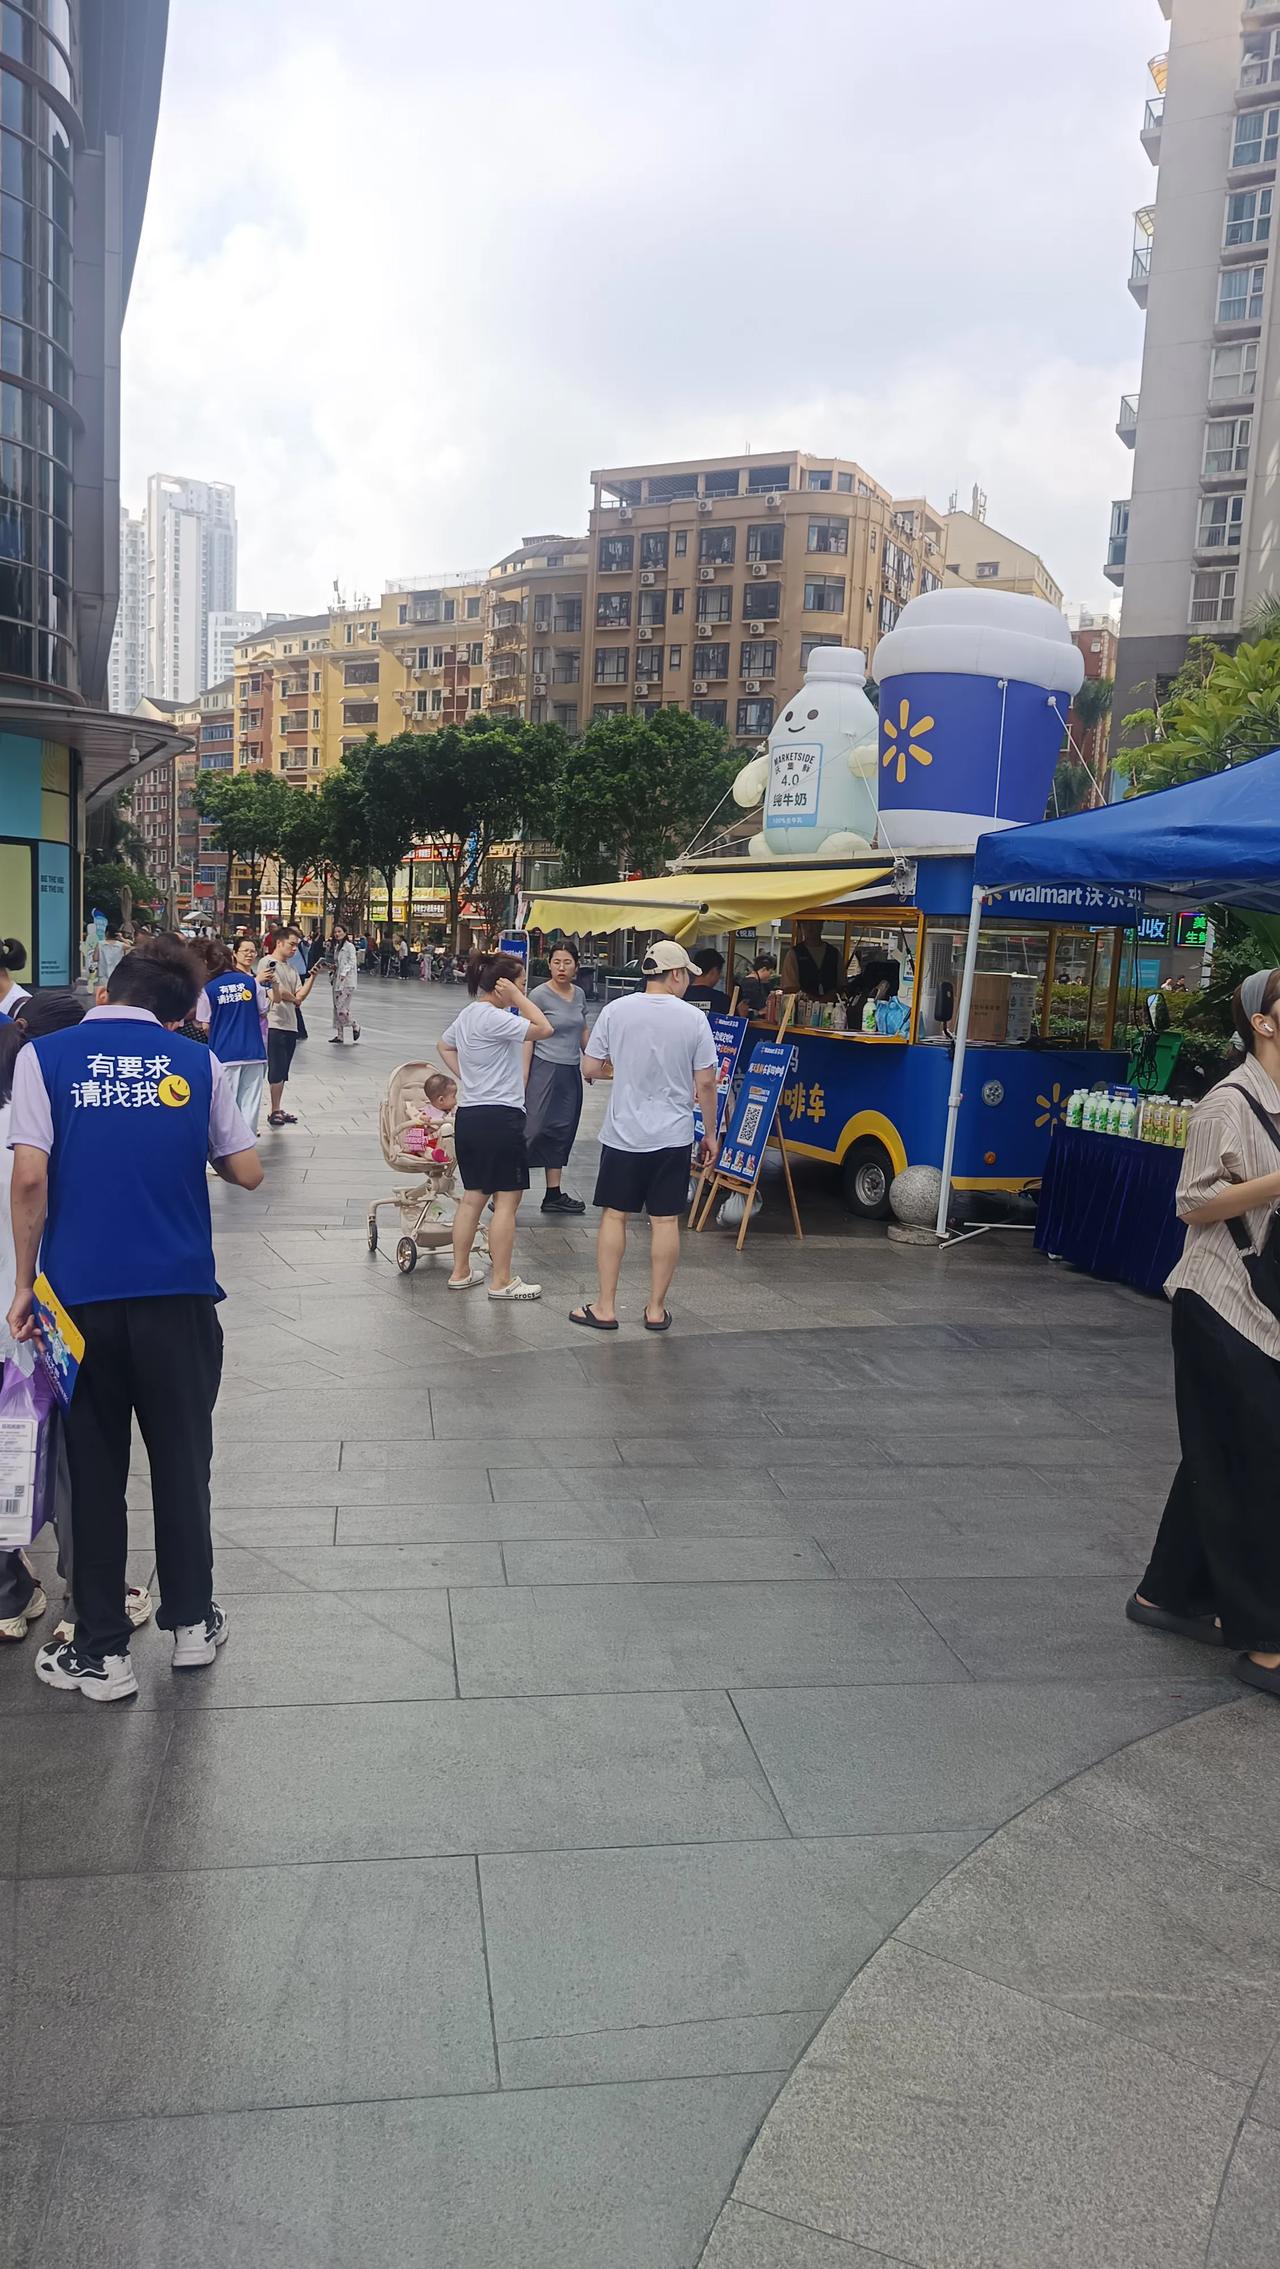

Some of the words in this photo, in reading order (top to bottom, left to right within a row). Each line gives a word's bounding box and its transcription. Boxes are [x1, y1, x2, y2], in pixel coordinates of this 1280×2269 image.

[774, 752, 815, 766] MARKETSIDE
[781, 774, 799, 786] 4.0
[773, 793, 807, 807] 纯牛奶
[1009, 886, 1082, 905] Walmart
[219, 982, 246, 994] 有要求
[216, 993, 243, 1005] 请找我
[86, 1053, 173, 1080] 有要求
[70, 1079, 161, 1108] 请找我
[779, 1082, 826, 1123] 啡车
